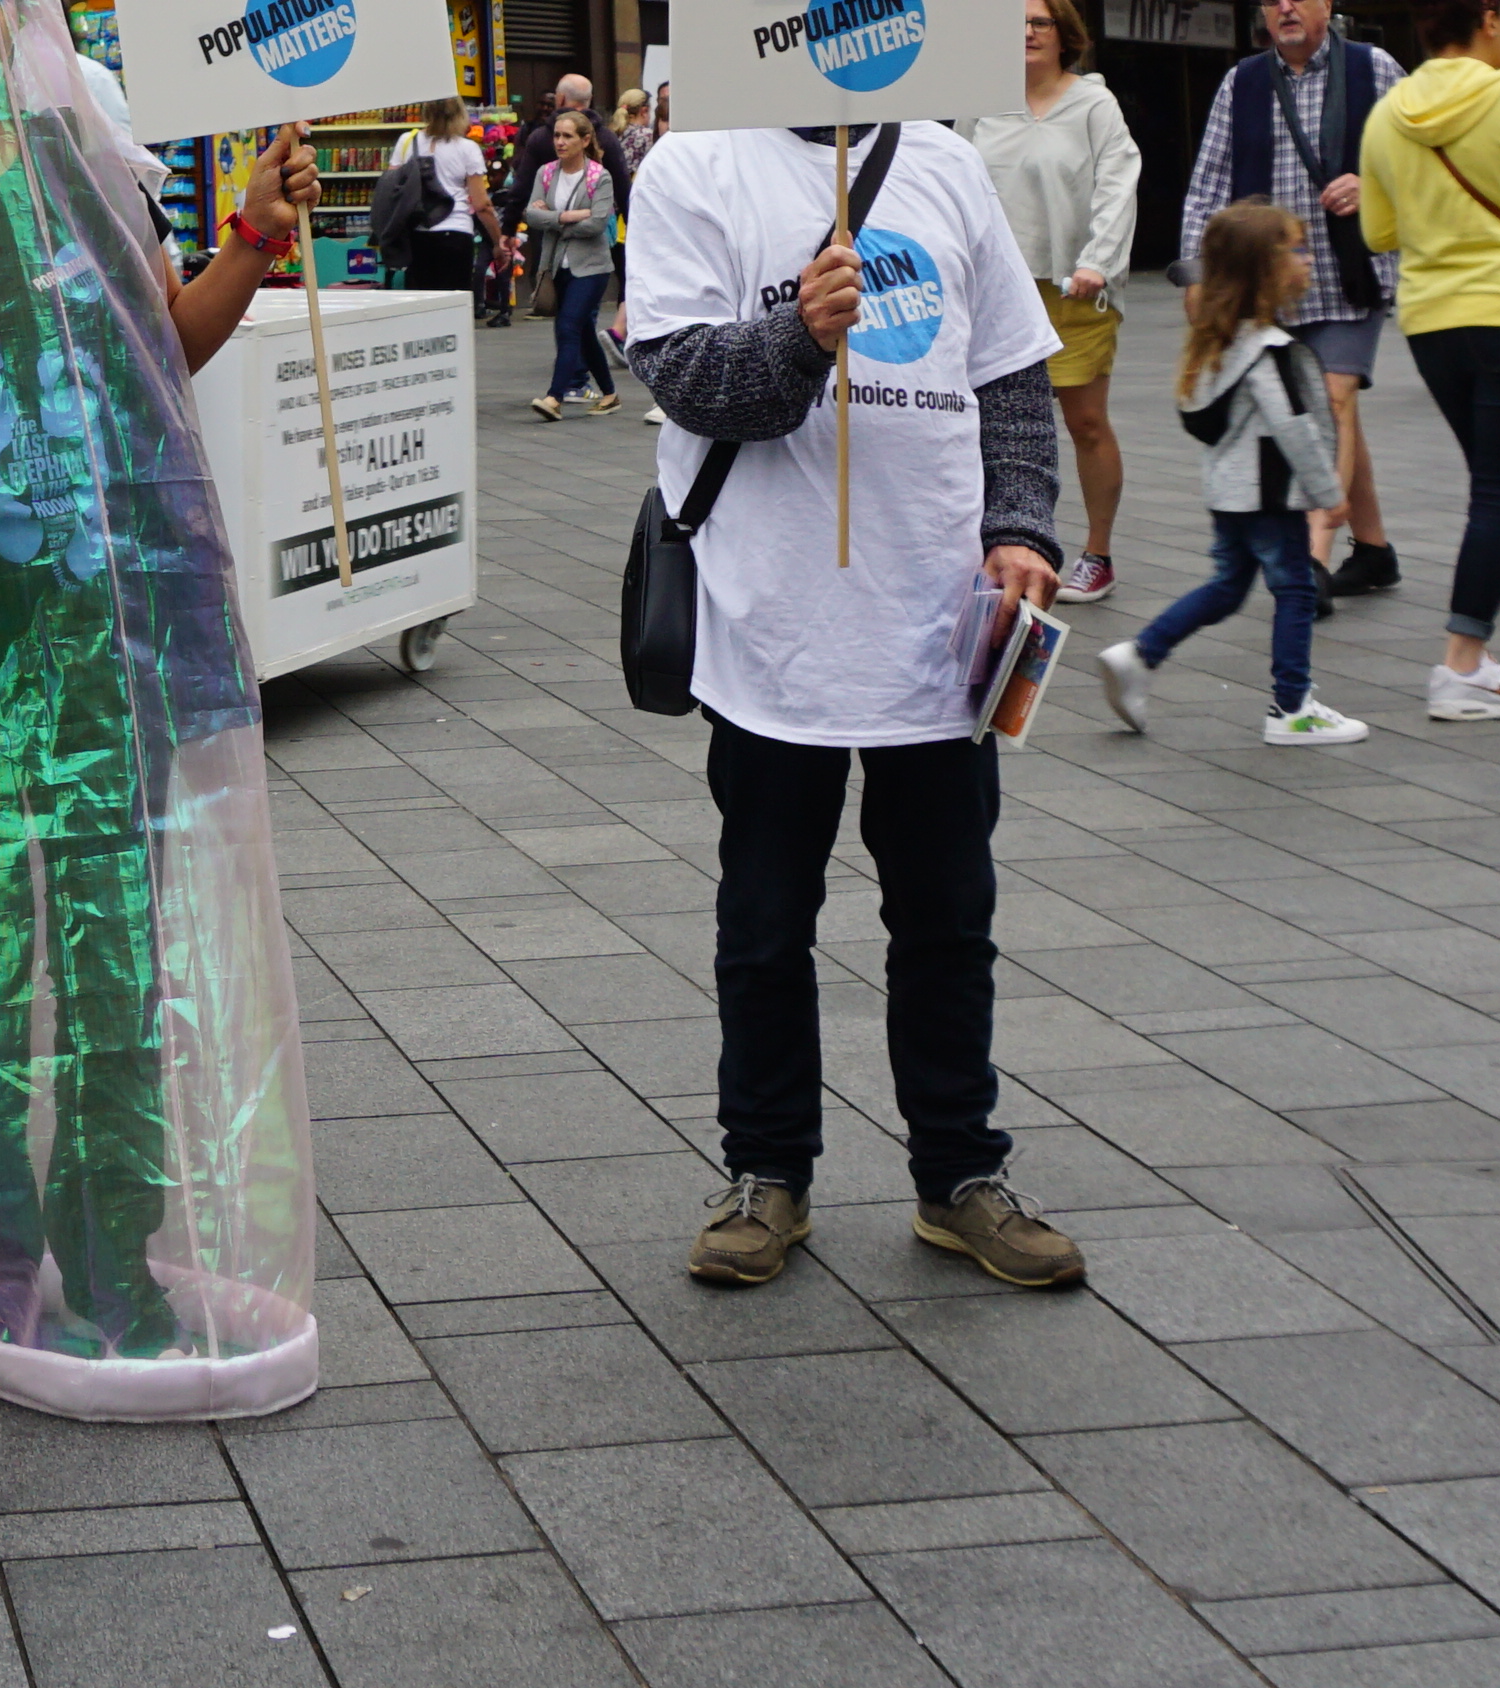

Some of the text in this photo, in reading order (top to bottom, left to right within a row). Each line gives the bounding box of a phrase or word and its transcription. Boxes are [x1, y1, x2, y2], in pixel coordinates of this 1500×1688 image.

[255, 4, 357, 74] MATTERS
[813, 10, 925, 75] MATTERS
[848, 280, 943, 334] ATTERS
[276, 357, 327, 383] ABRAHA
[915, 389, 967, 413] counts
[11, 433, 49, 460] LAST
[366, 428, 425, 472] ALLAH
[33, 493, 76, 519] ROOM
[281, 542, 321, 581] WILL
[358, 525, 381, 559] DO
[382, 515, 413, 551] THE
[414, 503, 460, 543] SAME?
